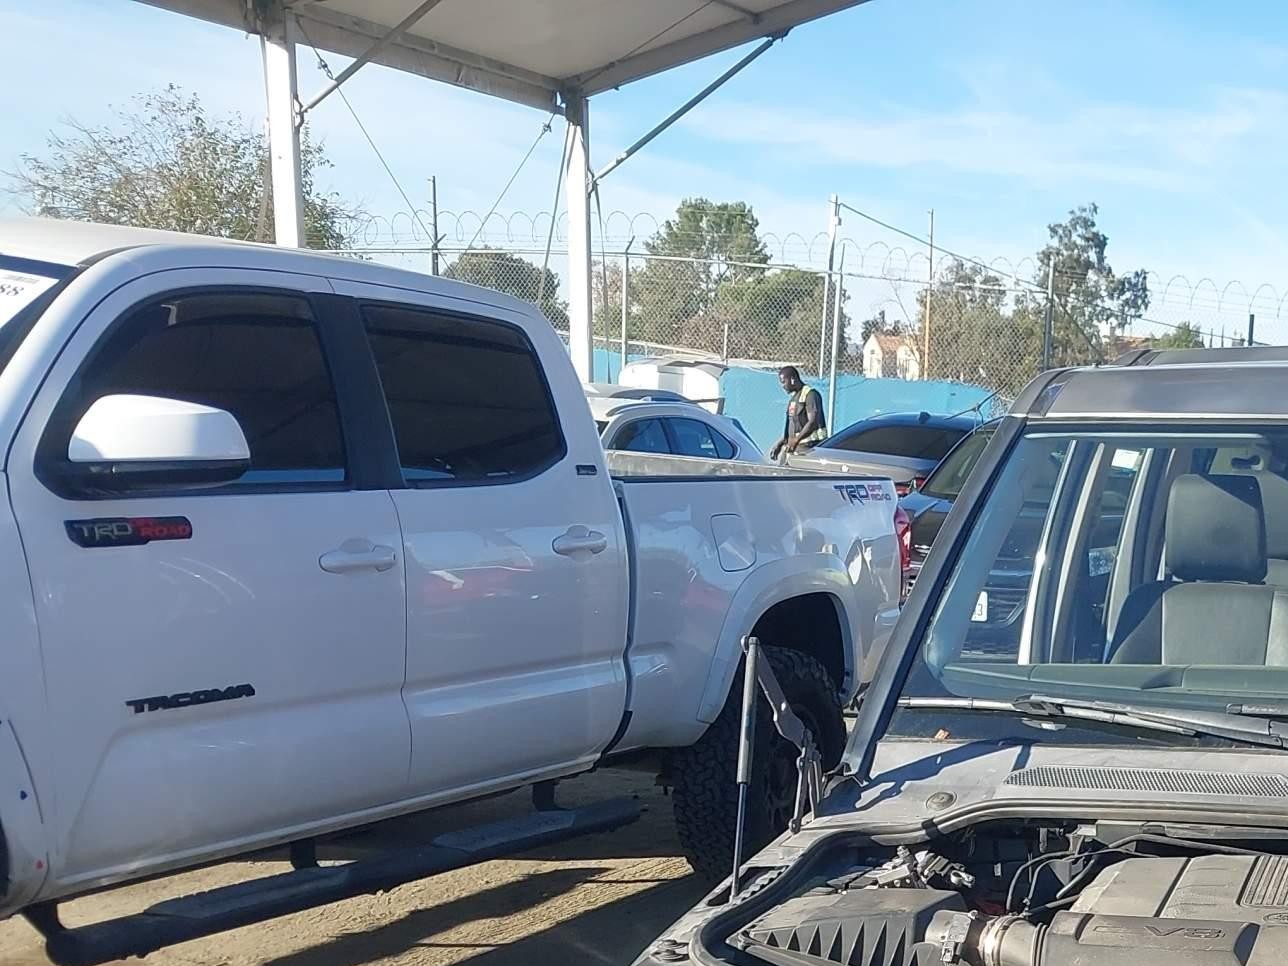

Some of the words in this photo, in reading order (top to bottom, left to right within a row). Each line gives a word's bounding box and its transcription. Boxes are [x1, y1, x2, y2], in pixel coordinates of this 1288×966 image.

[833, 484, 869, 505] TRD
[74, 522, 132, 541] TRD
[125, 683, 256, 715] TACOMA
